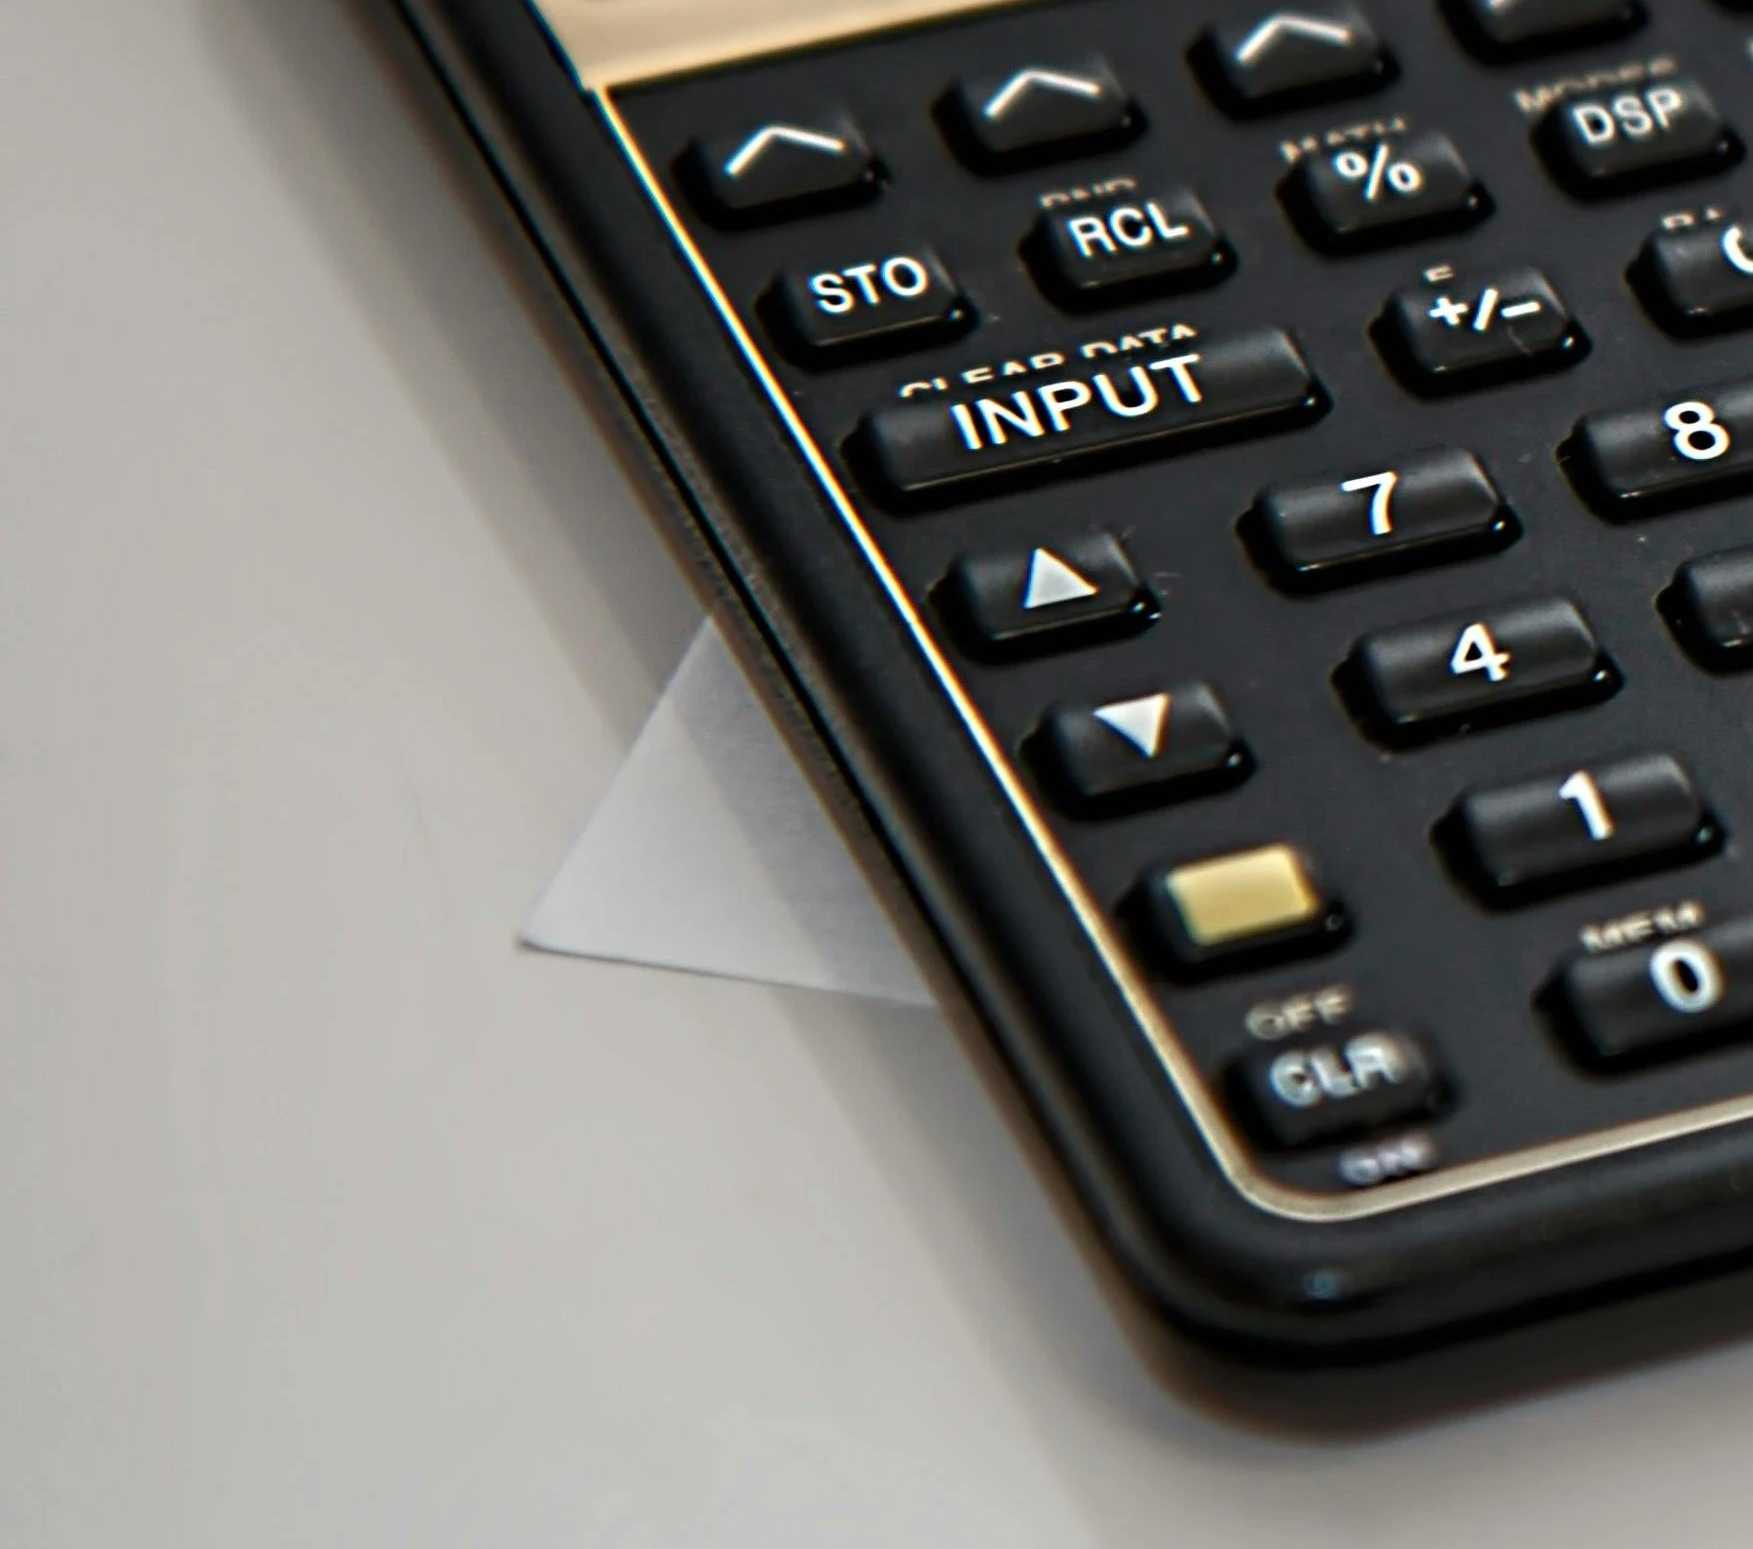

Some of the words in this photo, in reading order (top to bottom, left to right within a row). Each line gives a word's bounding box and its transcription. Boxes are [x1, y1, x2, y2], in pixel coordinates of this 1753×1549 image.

[1571, 86, 1686, 145] DSP
[1334, 141, 1422, 201] %
[1067, 200, 1190, 258] RCL
[809, 256, 930, 315] STO
[949, 353, 1204, 451] INPUT
[1664, 398, 1731, 461] 8
[1340, 470, 1399, 536] 7
[1449, 622, 1511, 682] 4
[1559, 770, 1614, 841] 1
[1649, 938, 1725, 1015] 0
[1244, 982, 1352, 1042] OFF
[1269, 1029, 1408, 1108] CLR
